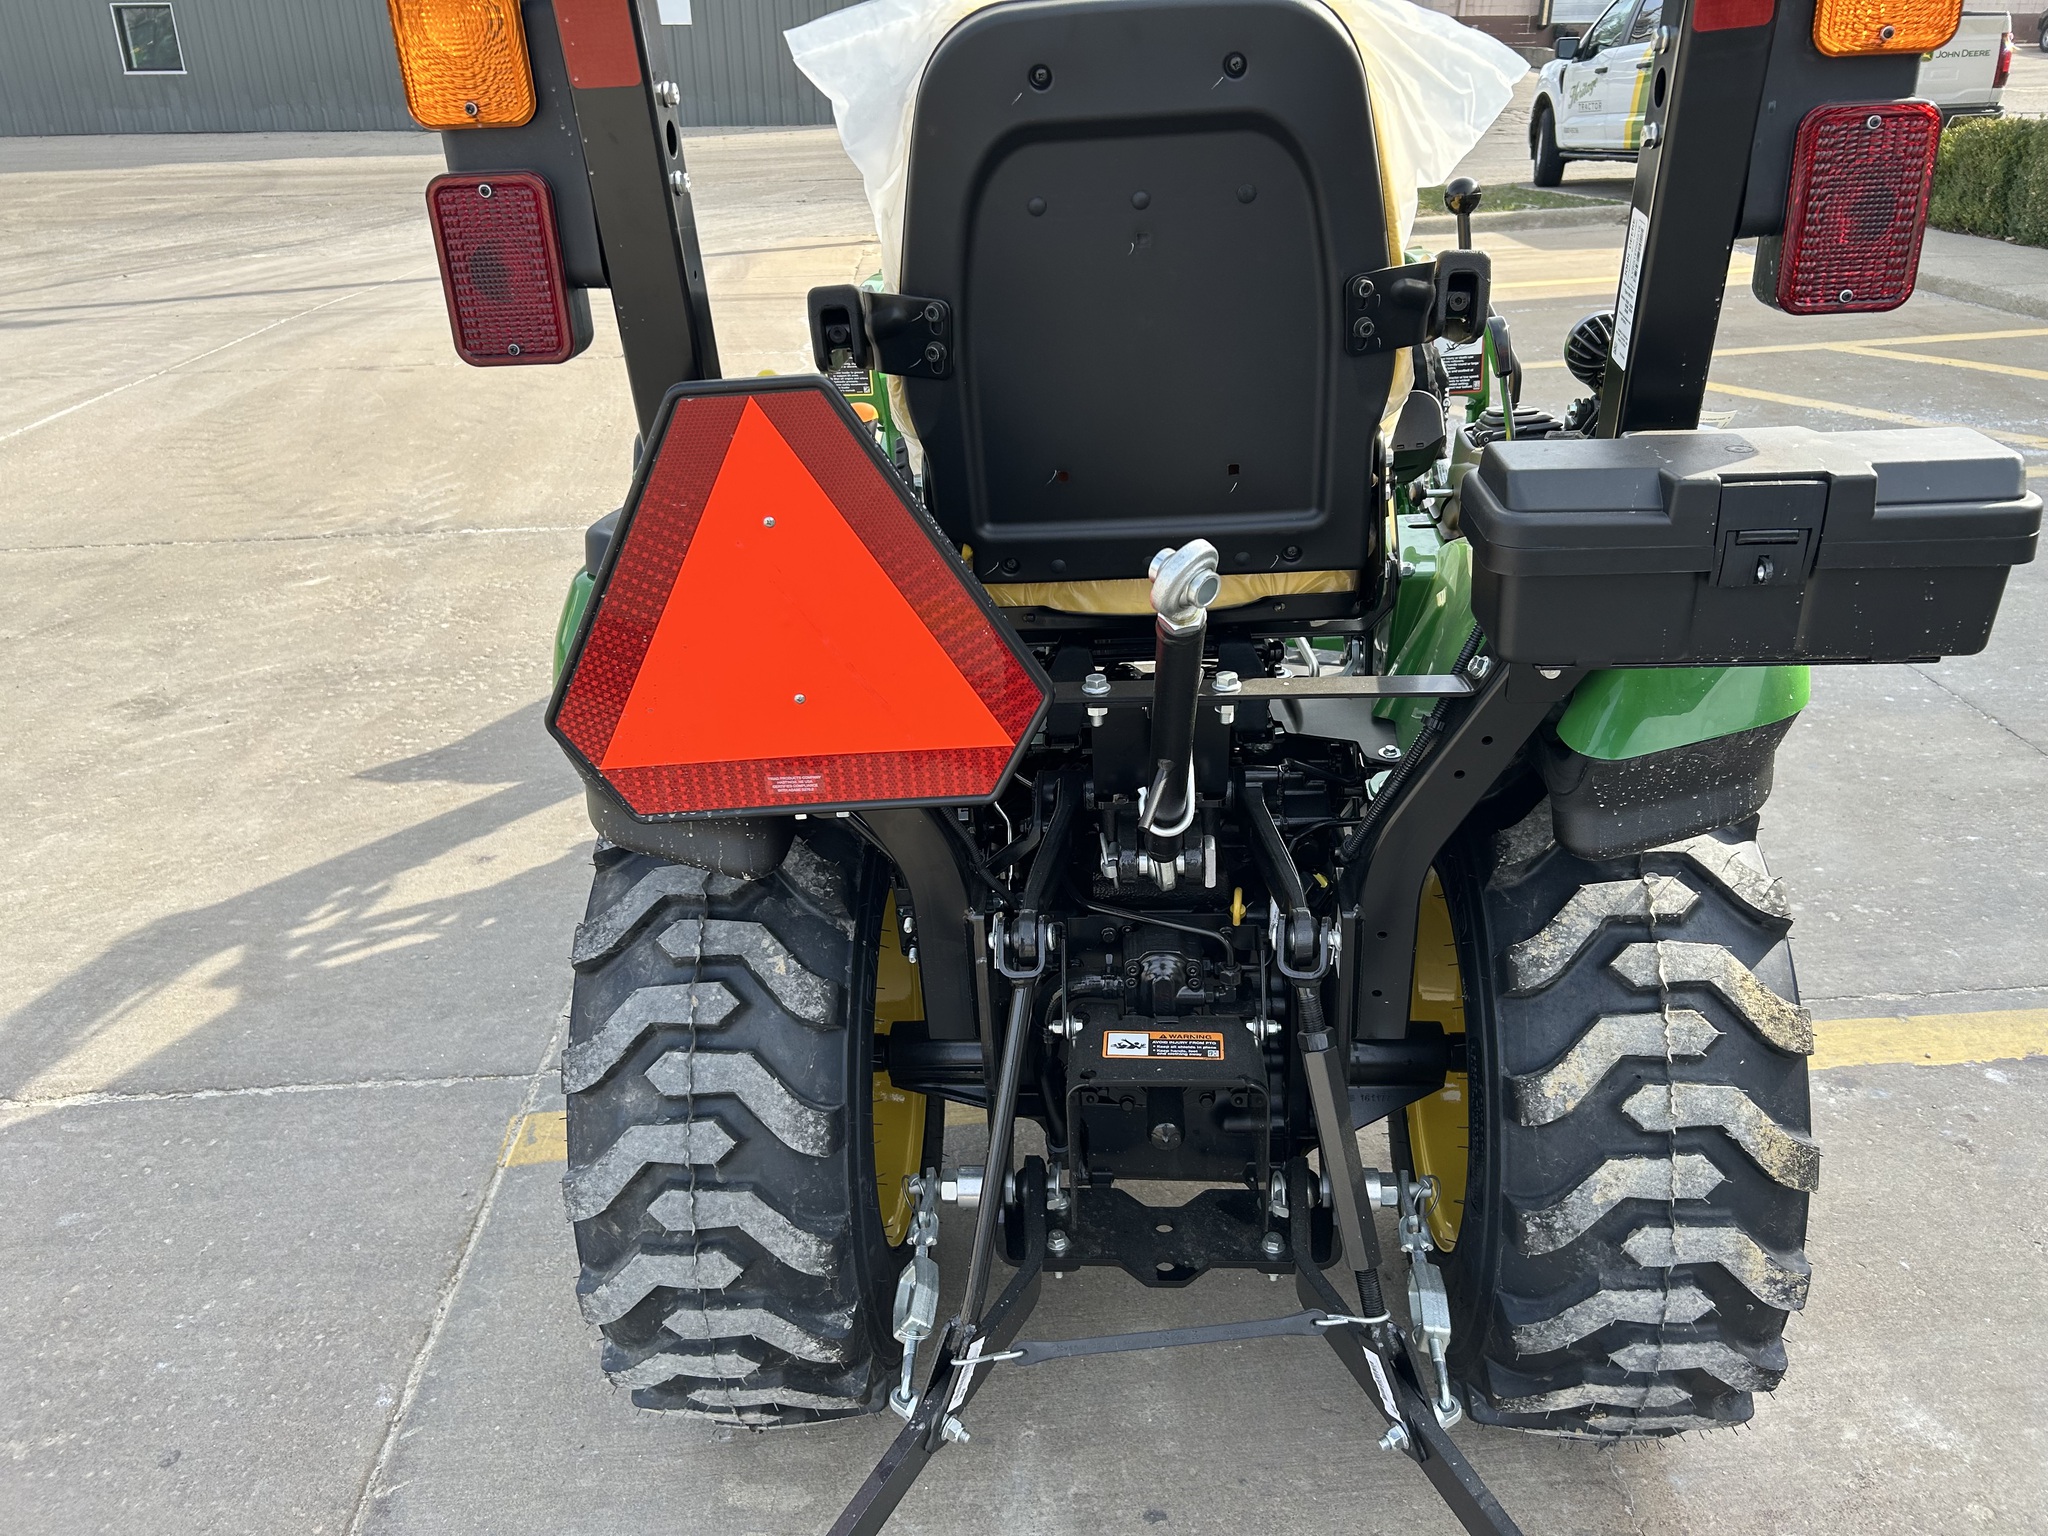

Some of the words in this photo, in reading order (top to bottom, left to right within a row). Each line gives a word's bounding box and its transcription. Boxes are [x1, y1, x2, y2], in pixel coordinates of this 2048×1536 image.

[1935, 50, 1960, 59] JOHN
[1961, 49, 1991, 57] DEERE
[1578, 102, 1602, 110] TRACTOR
